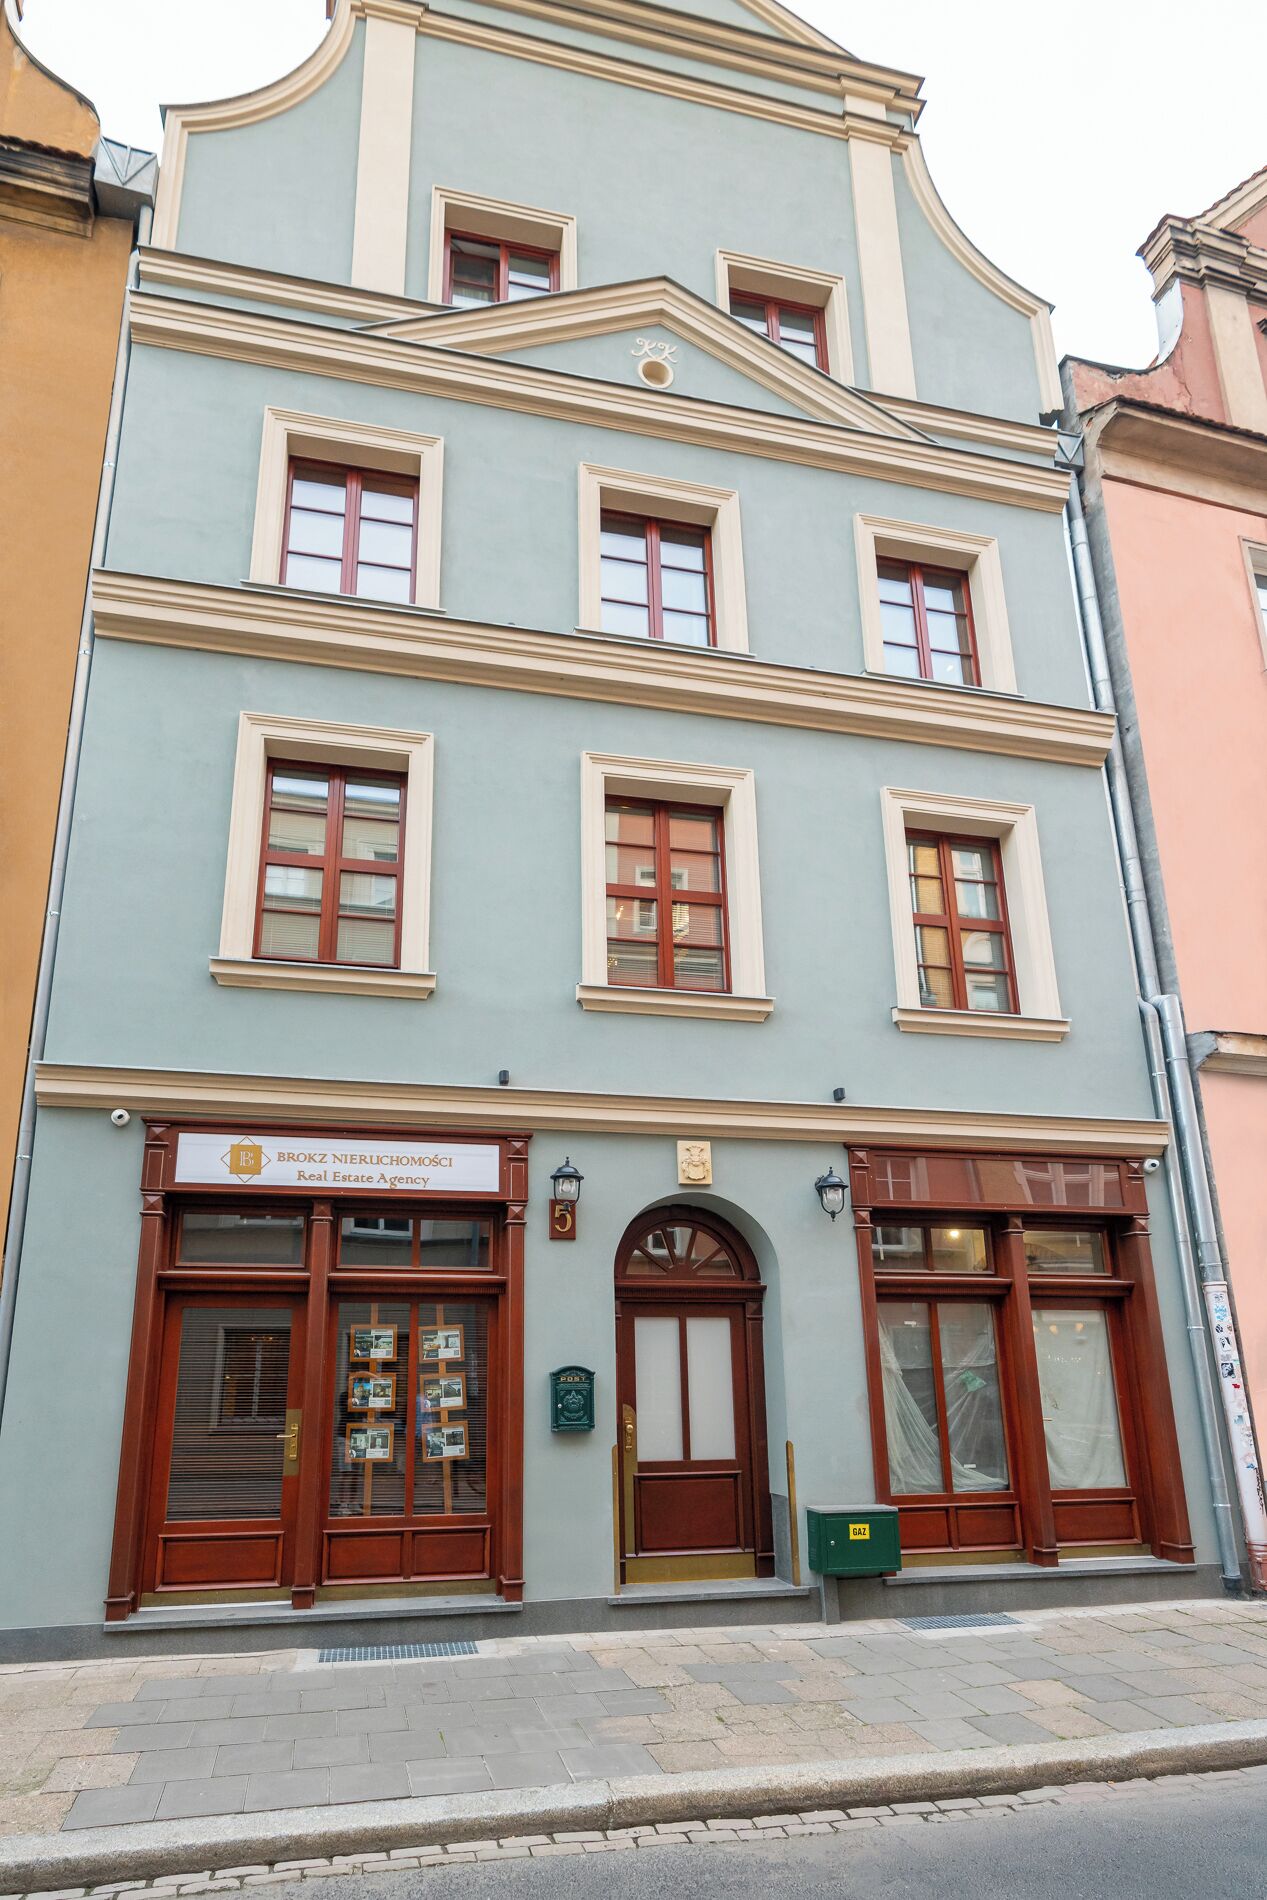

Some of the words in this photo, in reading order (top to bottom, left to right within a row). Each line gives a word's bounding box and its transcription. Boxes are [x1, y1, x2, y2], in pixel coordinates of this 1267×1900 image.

[276, 1151, 327, 1164] BROKZ
[331, 1153, 454, 1168] NIERUCHOMOŚCI
[296, 1170, 328, 1181] Real
[332, 1171, 374, 1183] Estate
[376, 1172, 430, 1189] Agency
[554, 1204, 573, 1232] 5
[852, 1527, 867, 1536] GAZ
